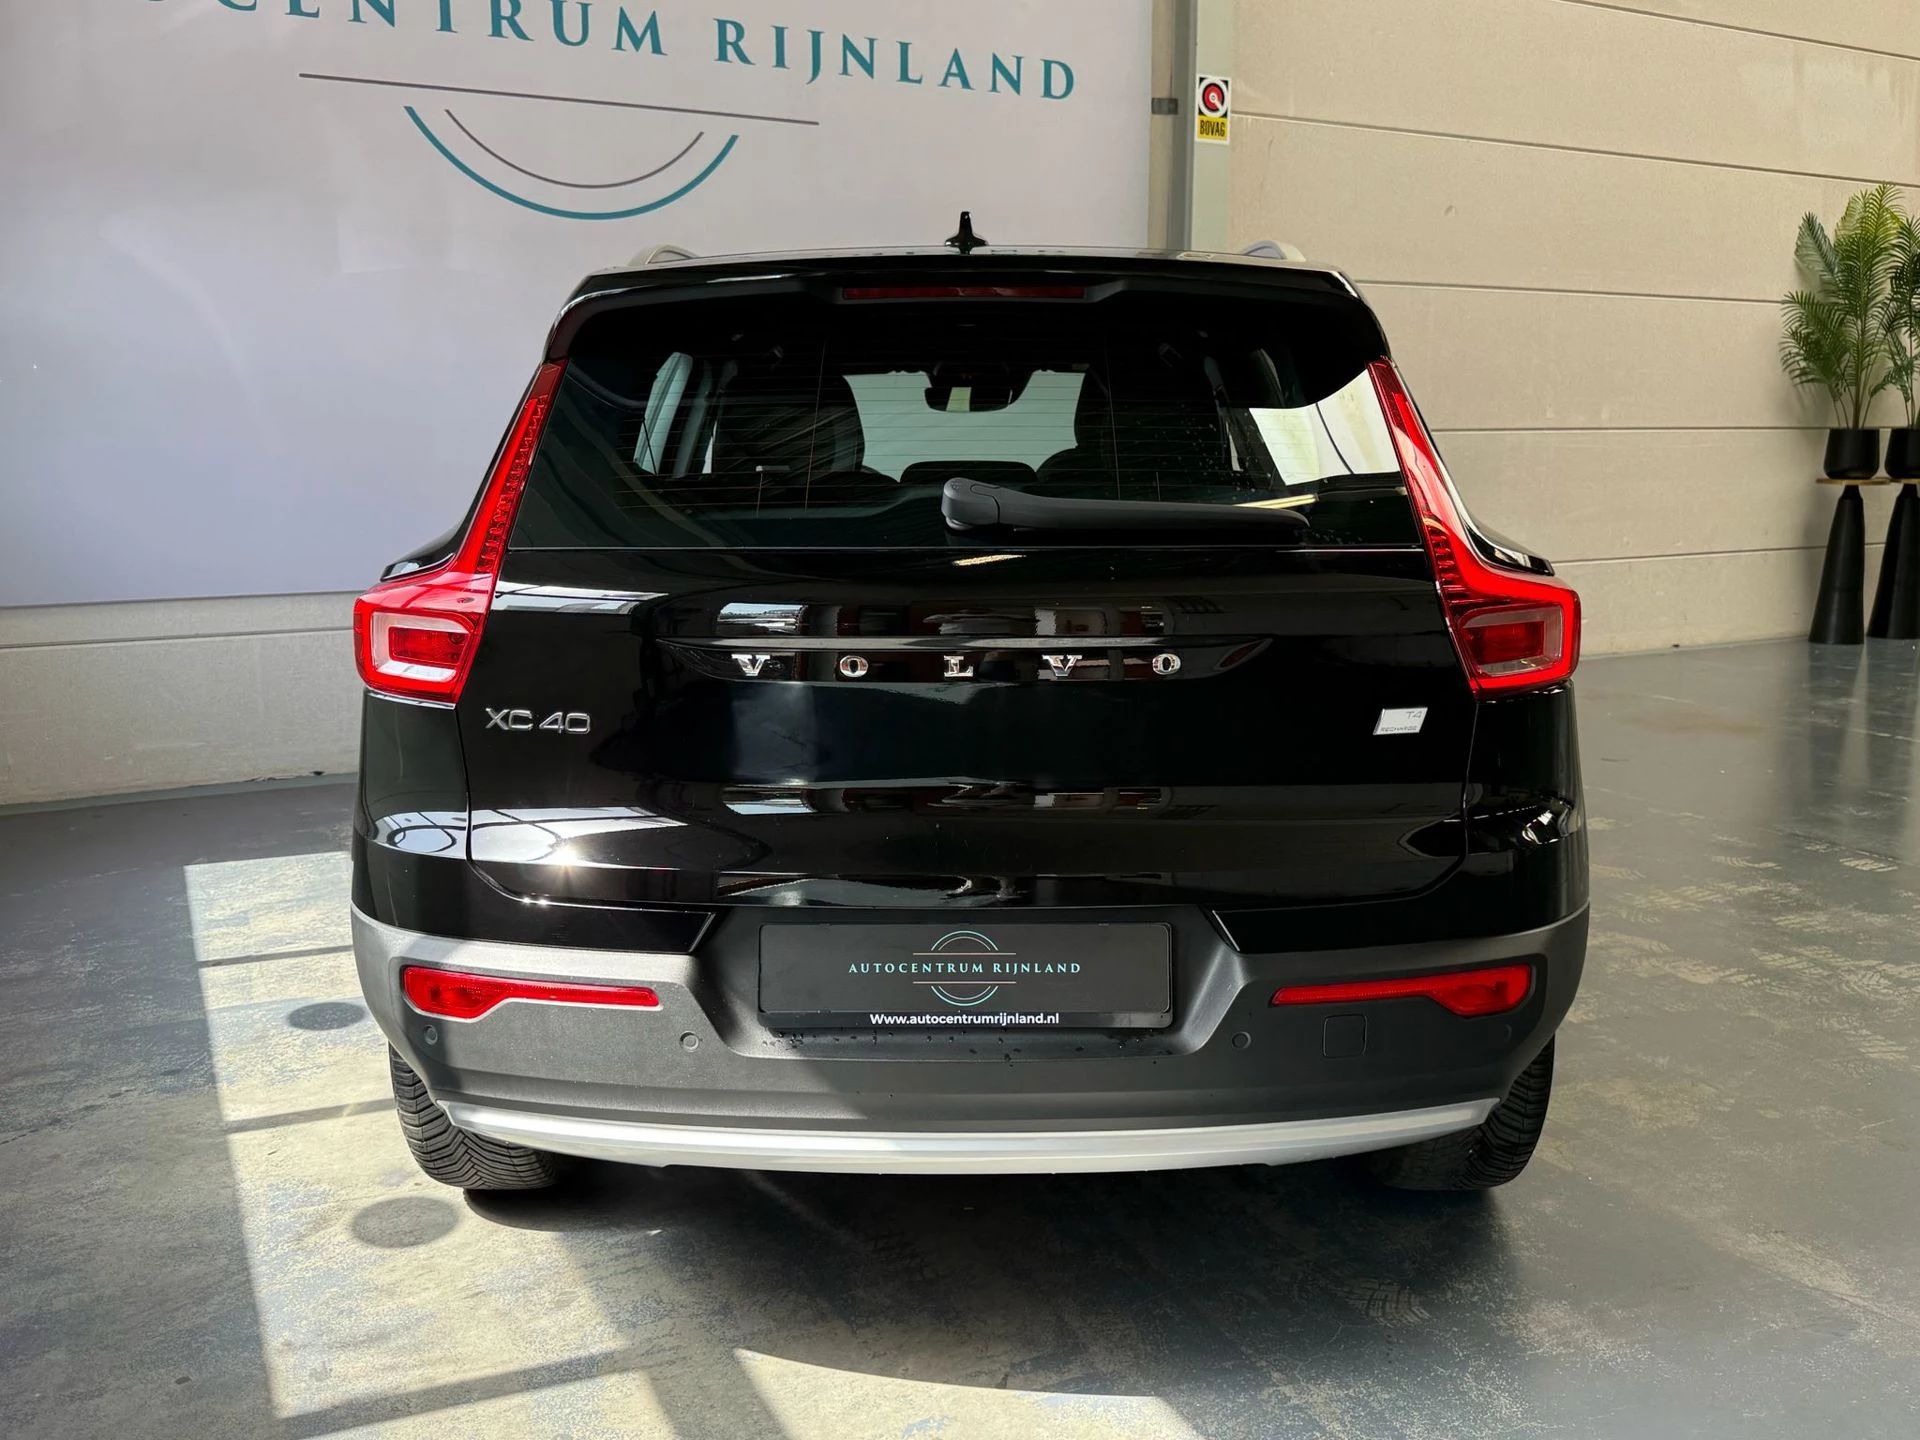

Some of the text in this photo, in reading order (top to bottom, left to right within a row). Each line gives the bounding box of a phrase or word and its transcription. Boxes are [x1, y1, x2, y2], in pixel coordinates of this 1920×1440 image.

[712, 18, 1075, 100] RIJNLAND
[1200, 119, 1226, 137] BOVAG
[731, 653, 1182, 678] VOLVO
[848, 963, 1082, 975] AUTOCENTRUM RIJNLAND
[869, 1012, 1060, 1027] Www.autocentrumrijnland.nl
